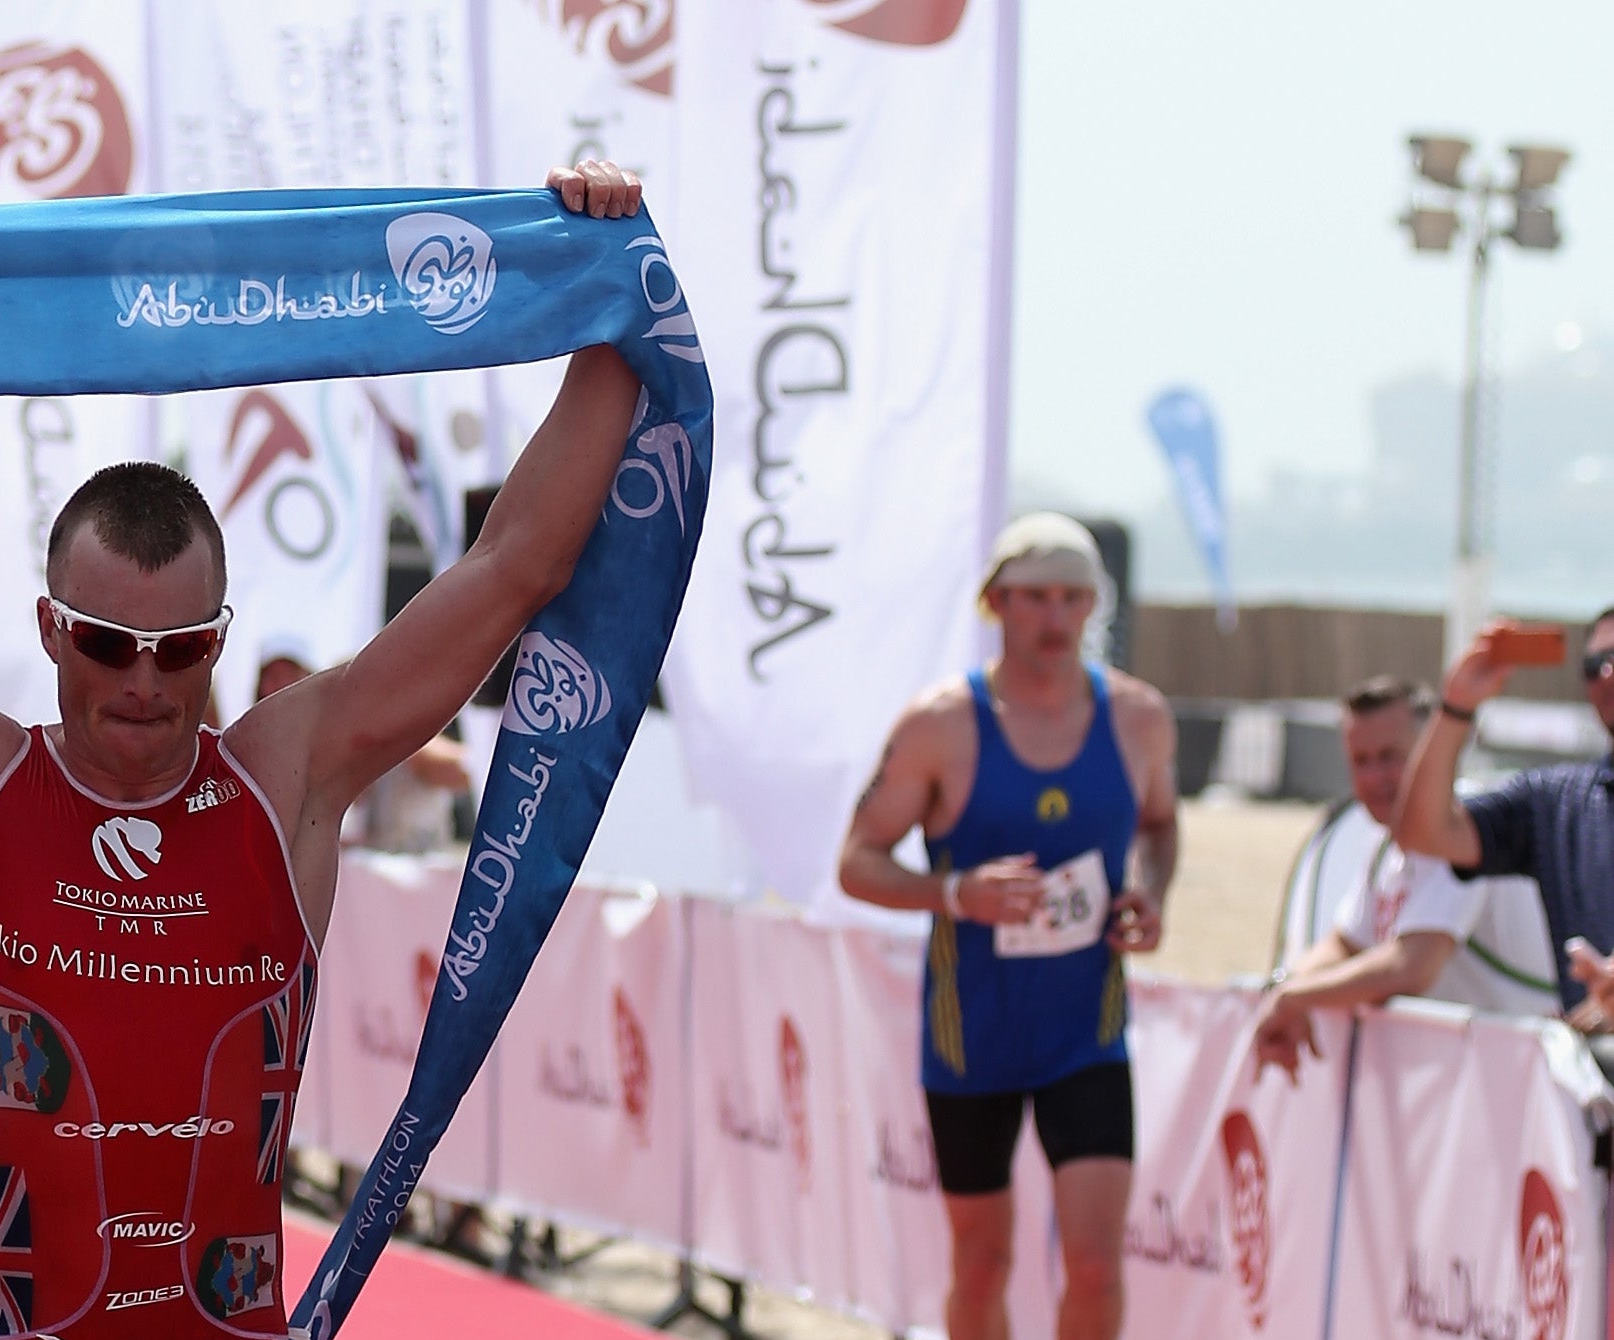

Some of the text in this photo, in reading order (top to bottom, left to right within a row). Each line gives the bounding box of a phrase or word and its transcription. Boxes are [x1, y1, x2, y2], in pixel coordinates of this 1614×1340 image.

[46, 943, 254, 986] Millennium
[260, 955, 286, 983] Re
[53, 1115, 235, 1140] cervélo
[112, 1221, 184, 1239] MAVIC
[105, 1285, 184, 1311] ZONE3
